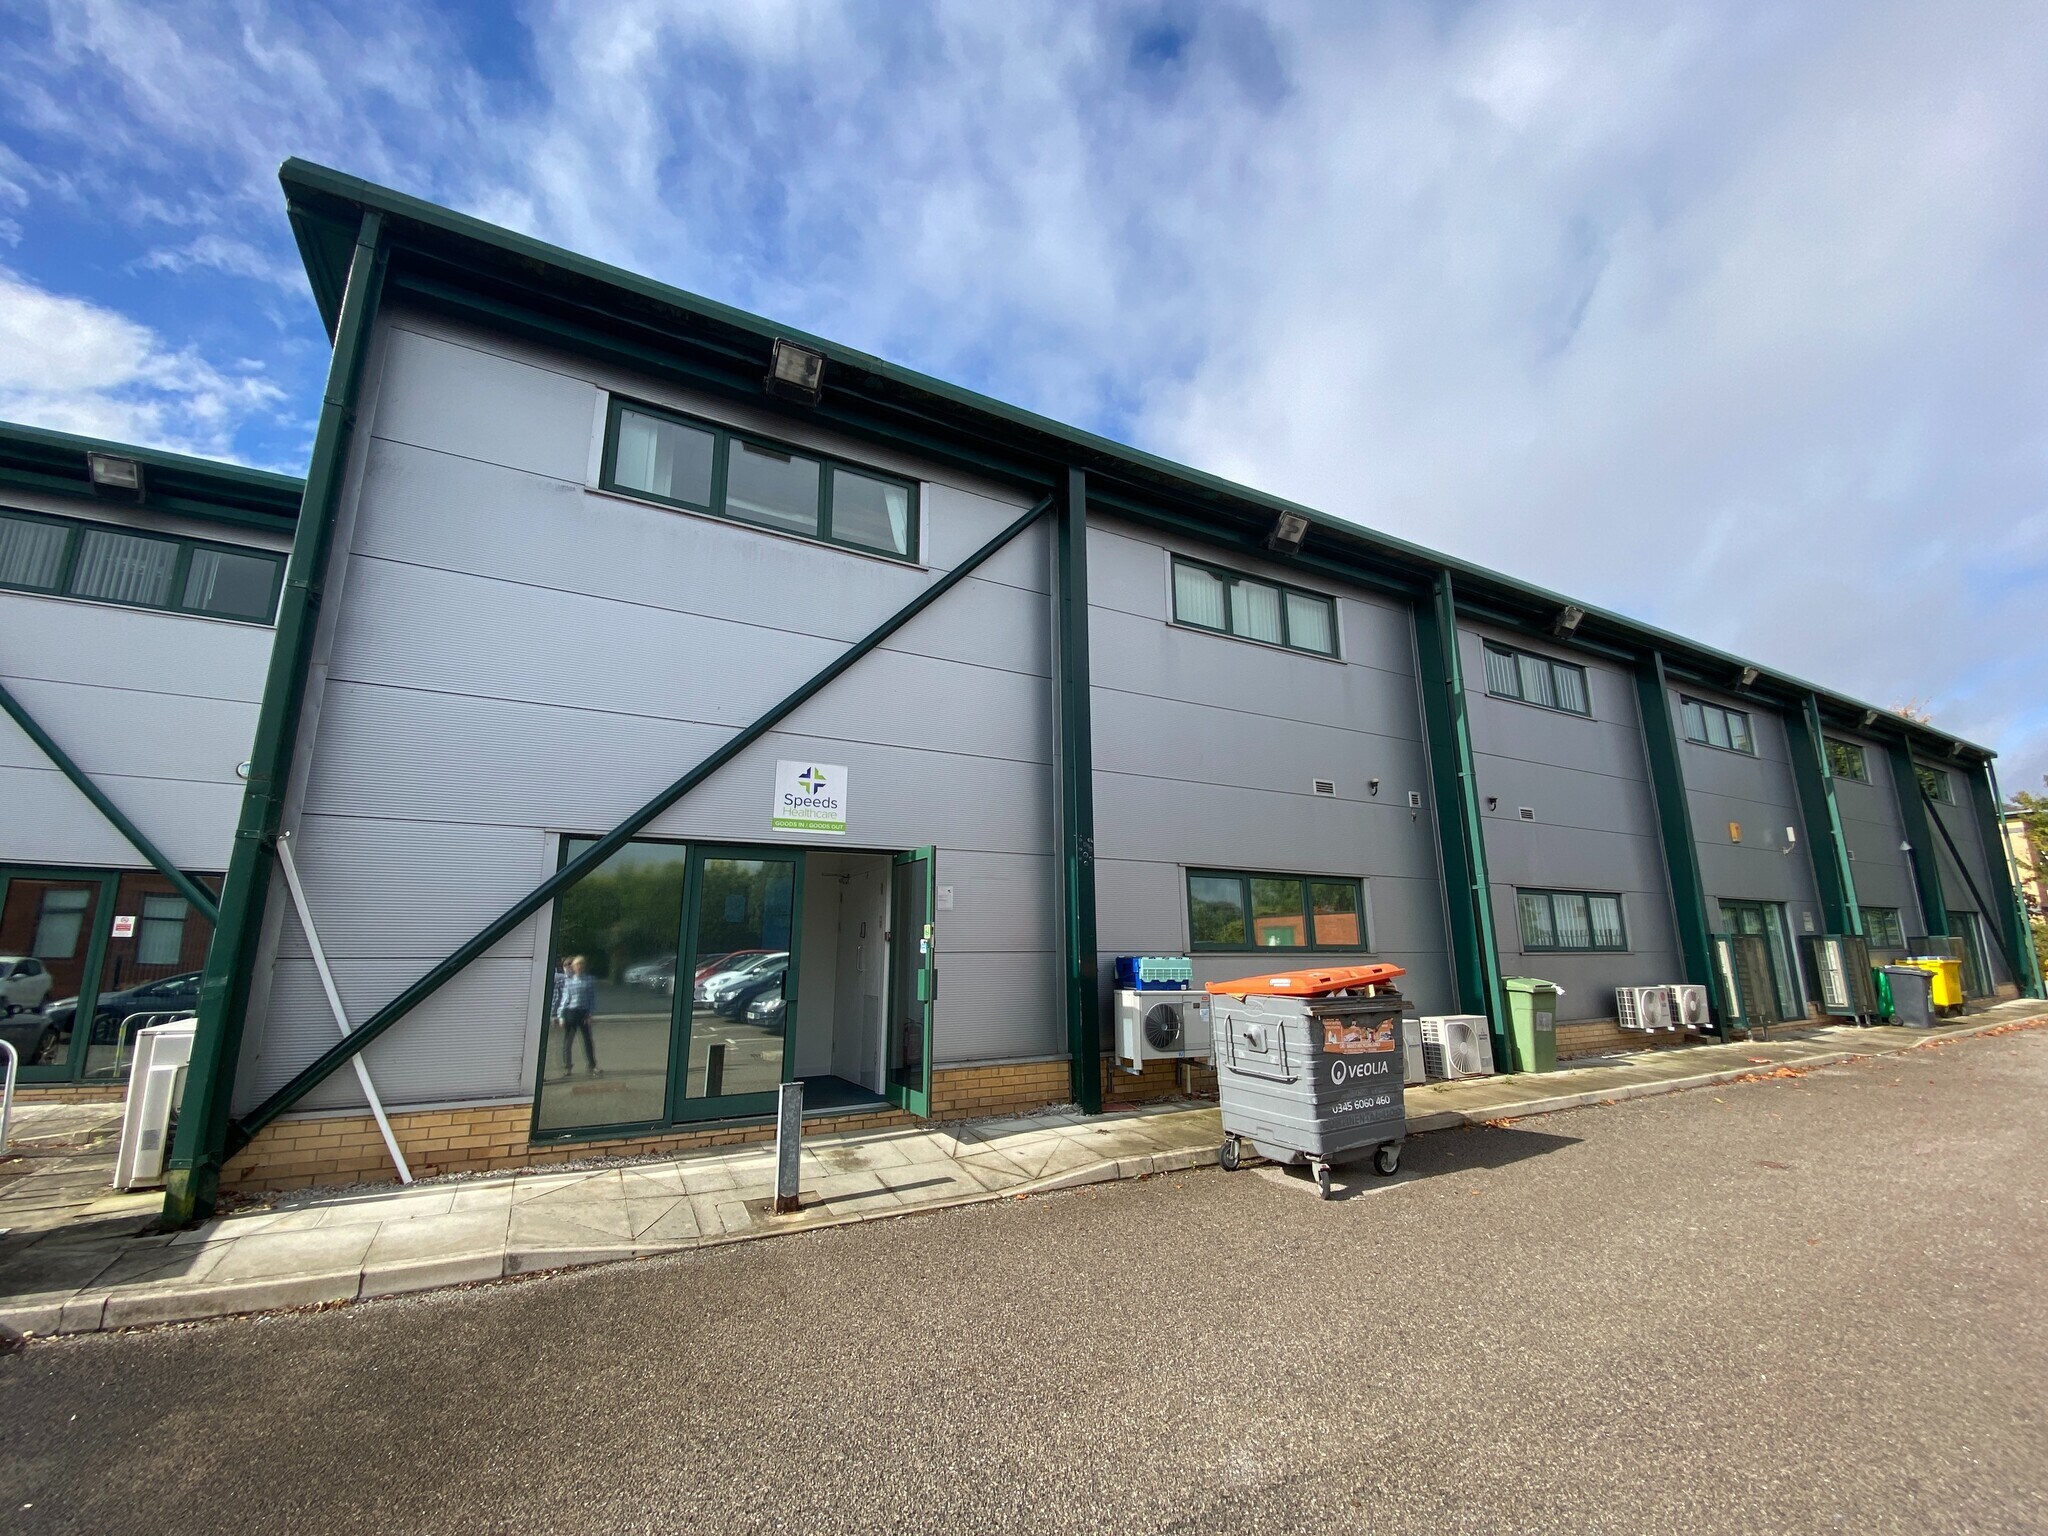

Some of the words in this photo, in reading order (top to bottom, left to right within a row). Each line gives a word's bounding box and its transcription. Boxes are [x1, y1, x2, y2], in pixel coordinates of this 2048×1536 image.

[784, 793, 838, 809] Speeds
[783, 807, 837, 819] Healthcare
[1348, 1061, 1388, 1078] VEOLIA
[1332, 1101, 1353, 1114] 0345
[1354, 1098, 1374, 1110] 6060
[1376, 1095, 1391, 1106] 460
